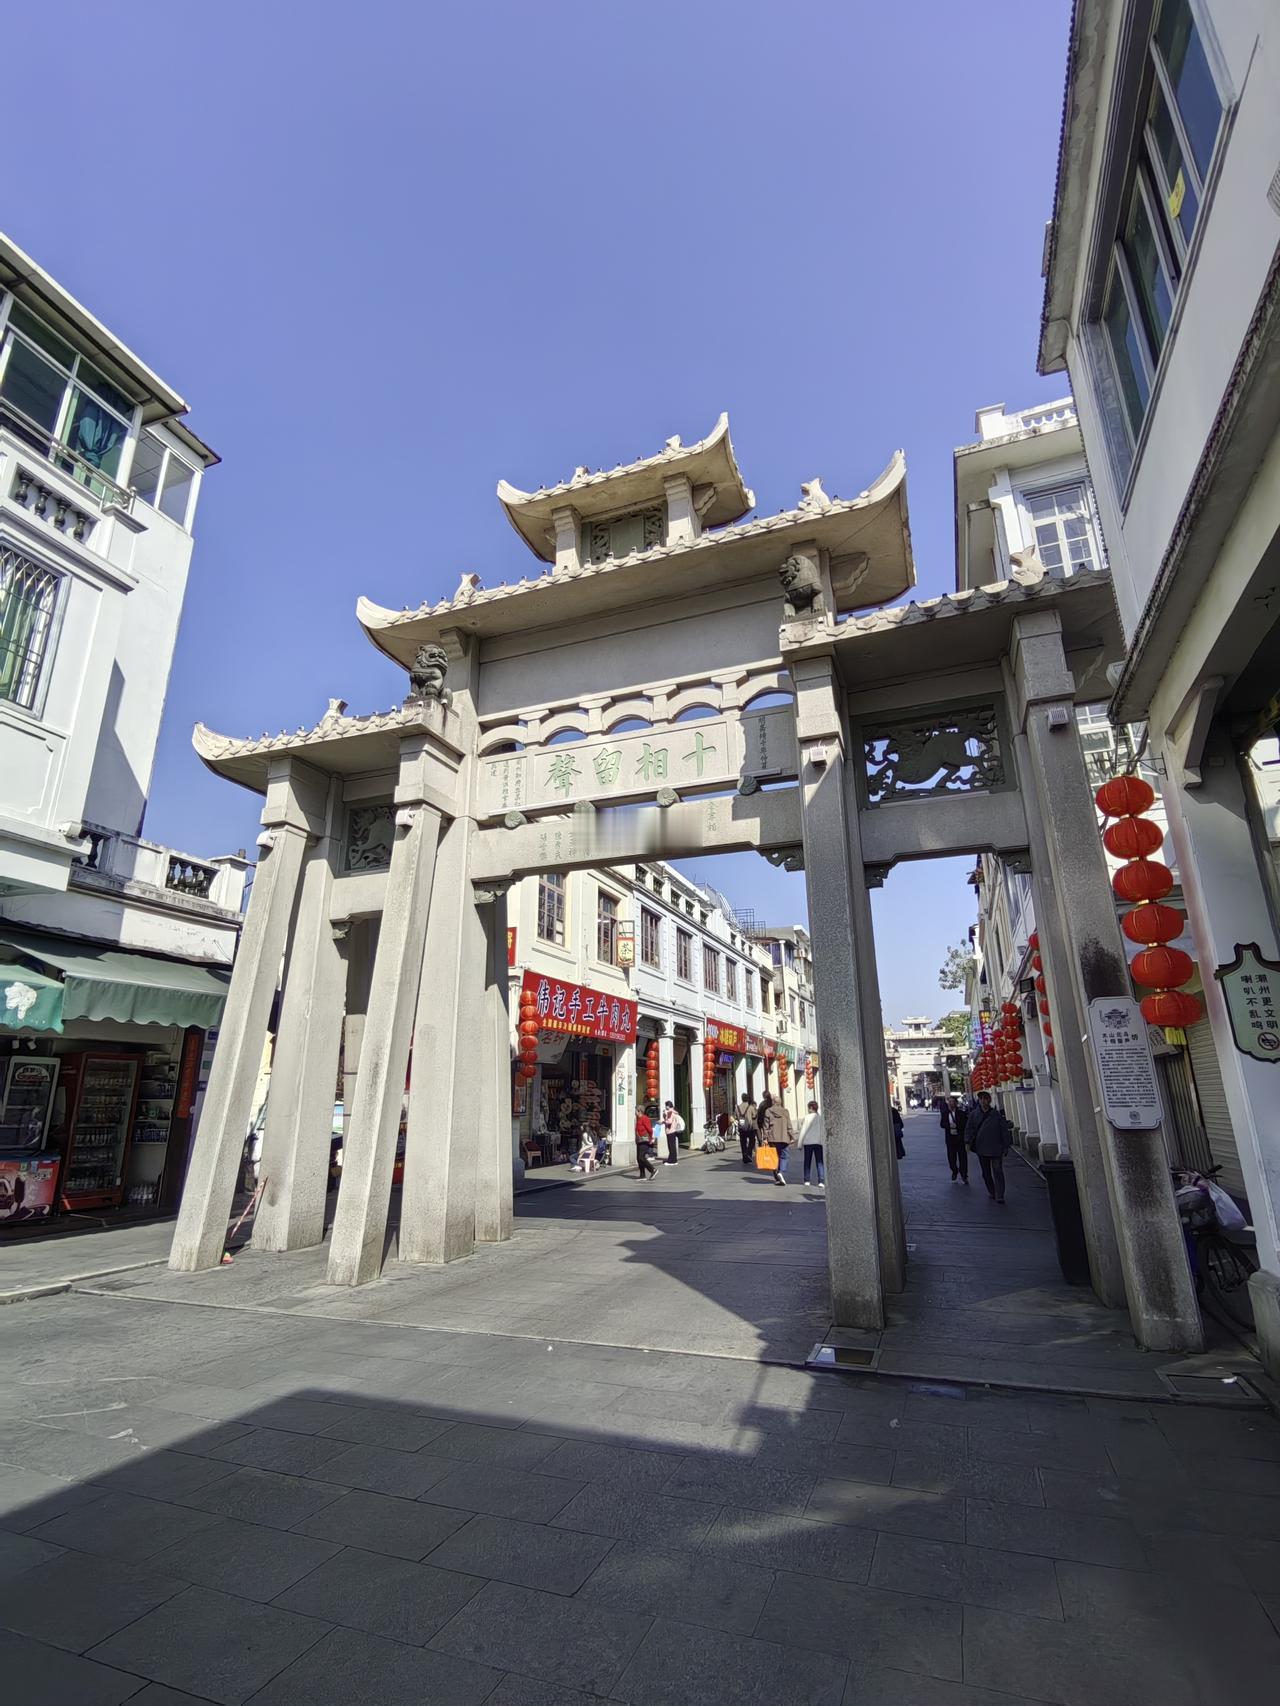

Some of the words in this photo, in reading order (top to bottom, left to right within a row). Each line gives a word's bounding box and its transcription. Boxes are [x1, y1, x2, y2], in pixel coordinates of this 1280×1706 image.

[544, 731, 717, 798] 十相留聲
[1240, 974, 1263, 1030] 喇叭不乱鸣
[1255, 974, 1279, 1030] 潮州更文明
